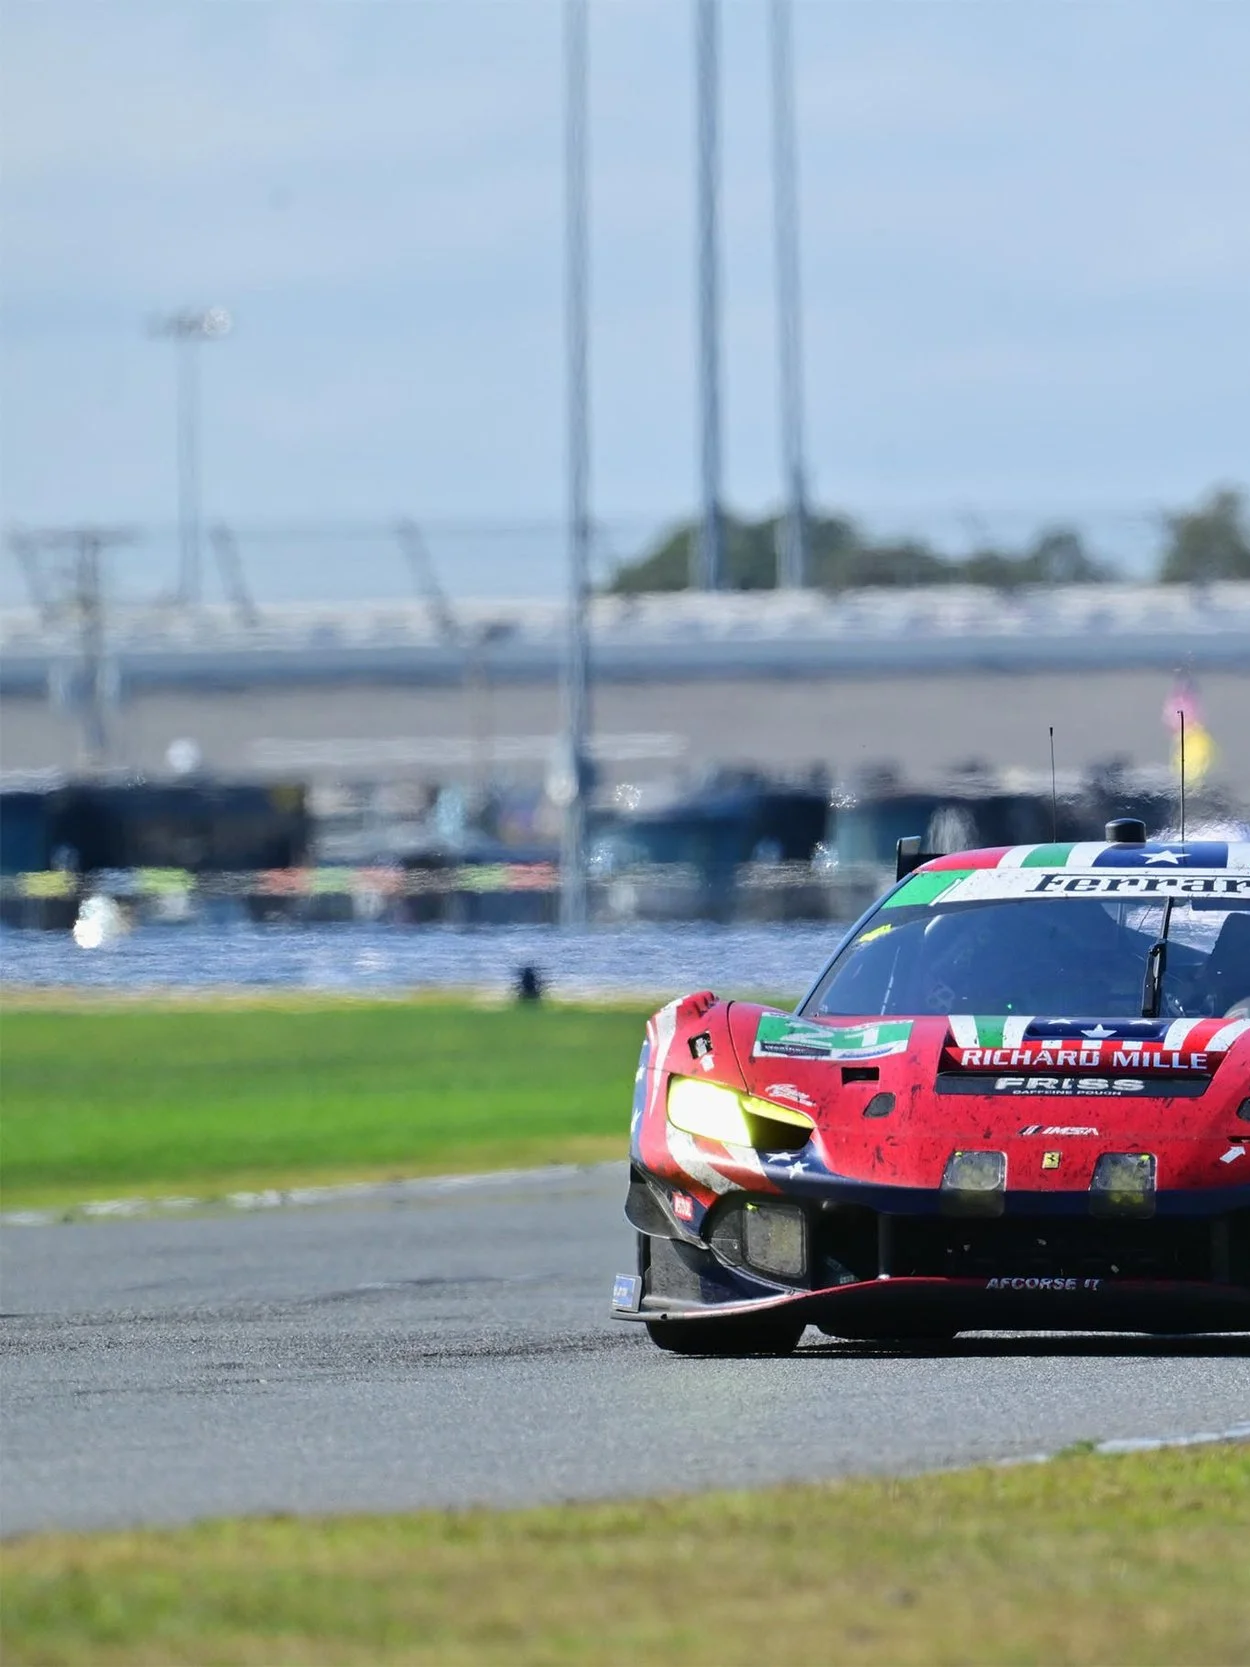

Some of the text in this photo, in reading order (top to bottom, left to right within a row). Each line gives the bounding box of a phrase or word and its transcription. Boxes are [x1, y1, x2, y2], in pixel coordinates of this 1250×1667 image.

[779, 1021, 880, 1048] 21
[960, 1049, 1208, 1070] RICHARD MILLE
[994, 1077, 1145, 1092] FRISS
[1043, 1126, 1099, 1136] IMSA
